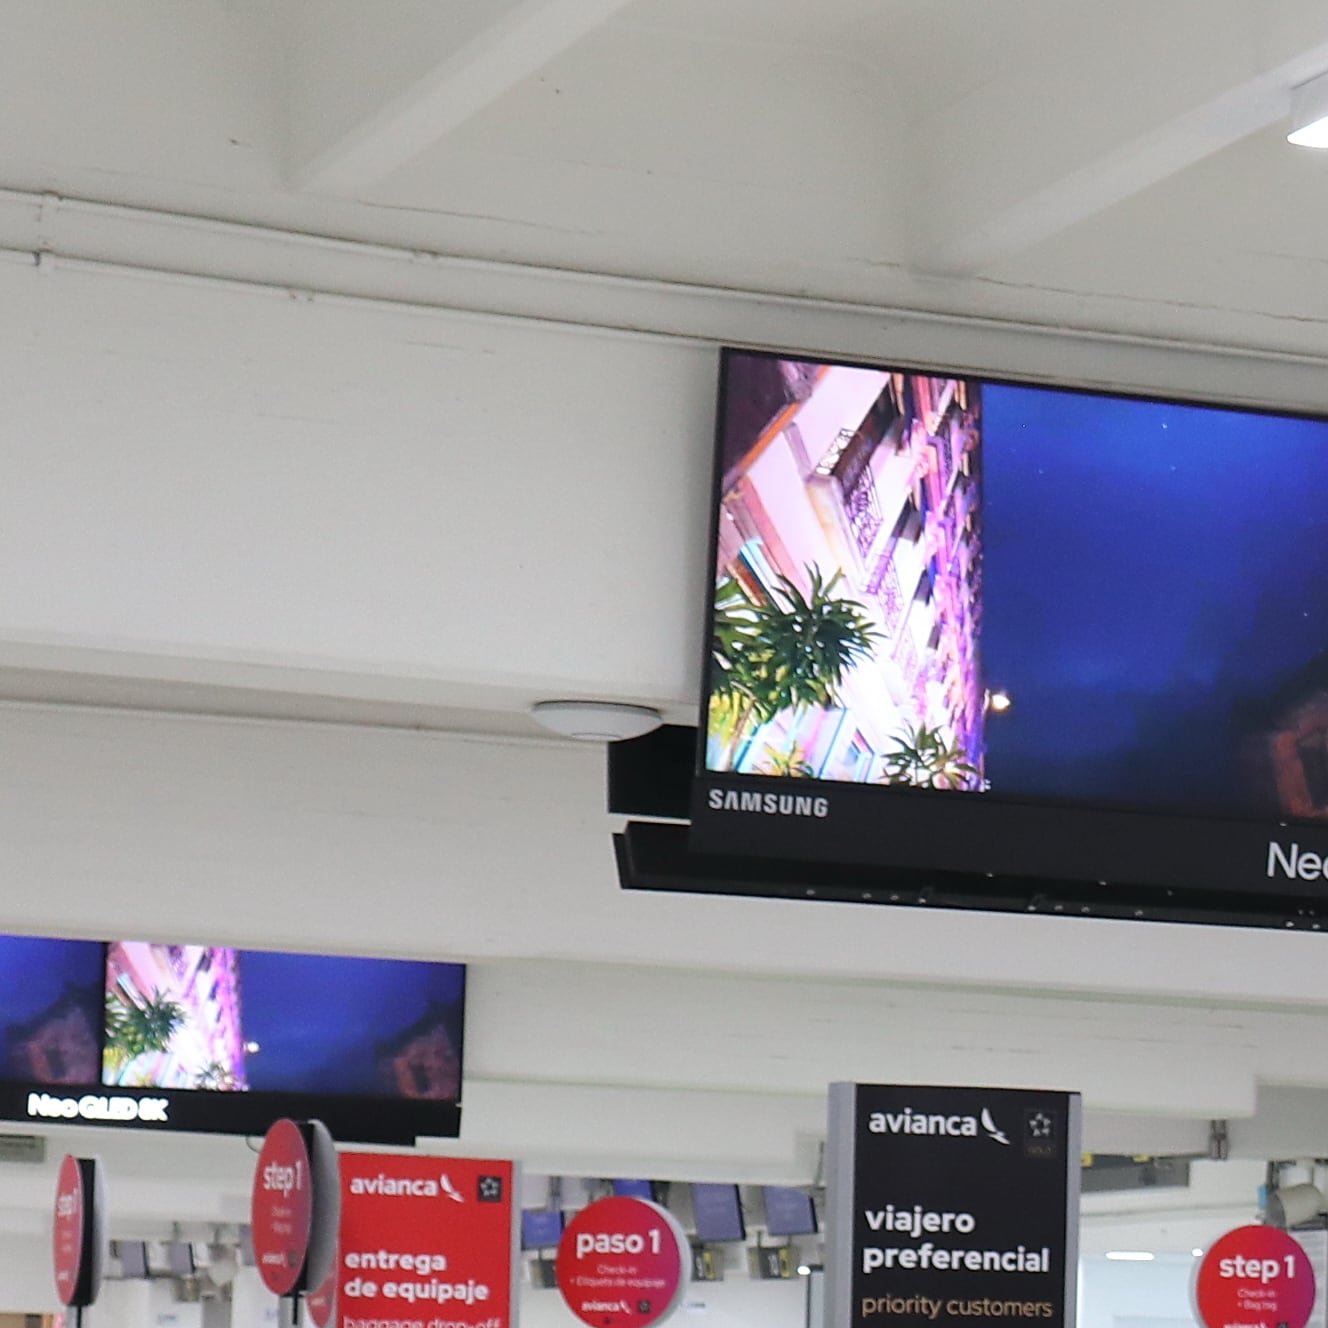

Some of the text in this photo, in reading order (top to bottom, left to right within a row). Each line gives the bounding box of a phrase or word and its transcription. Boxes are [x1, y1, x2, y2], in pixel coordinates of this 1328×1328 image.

[708, 788, 828, 818] SAMSUNG
[27, 1092, 169, 1122] Neo QLED 8K
[869, 1107, 977, 1137] avianca
[263, 1161, 303, 1198] step 1
[350, 1173, 438, 1197] avianca
[865, 1204, 975, 1238] viajero
[576, 1229, 661, 1259] paso 1
[863, 1242, 1049, 1274] preferencial
[344, 1250, 447, 1275] entrega
[1219, 1254, 1295, 1284] step 1
[344, 1277, 489, 1305] de equipaje
[581, 1300, 619, 1312] avianca
[861, 1294, 1053, 1319] priority customers
